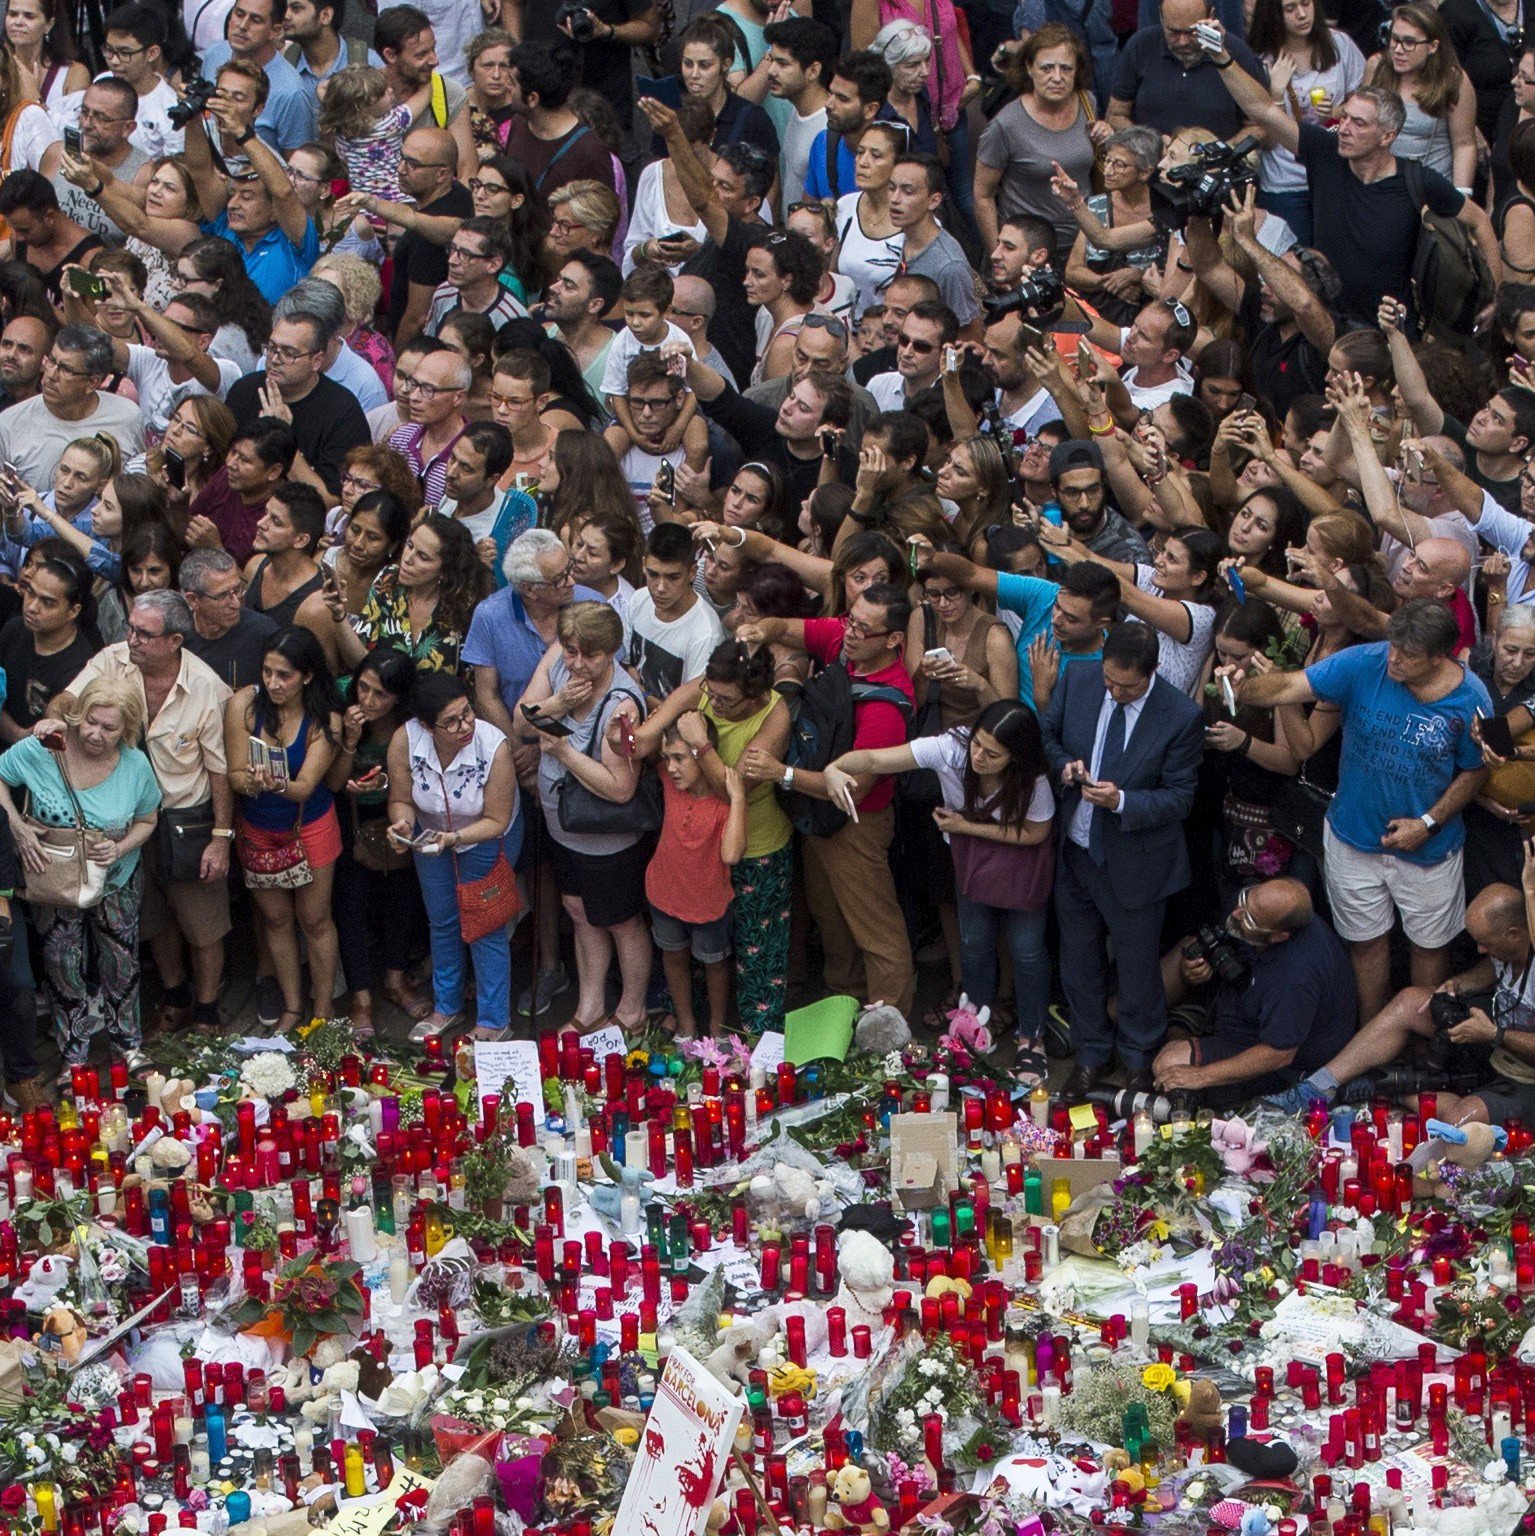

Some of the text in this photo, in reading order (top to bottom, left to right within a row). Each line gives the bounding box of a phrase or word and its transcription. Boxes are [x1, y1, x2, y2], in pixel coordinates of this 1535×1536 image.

[668, 1354, 697, 1388] PRAY FOR
[665, 1370, 723, 1434] BARCELONA
